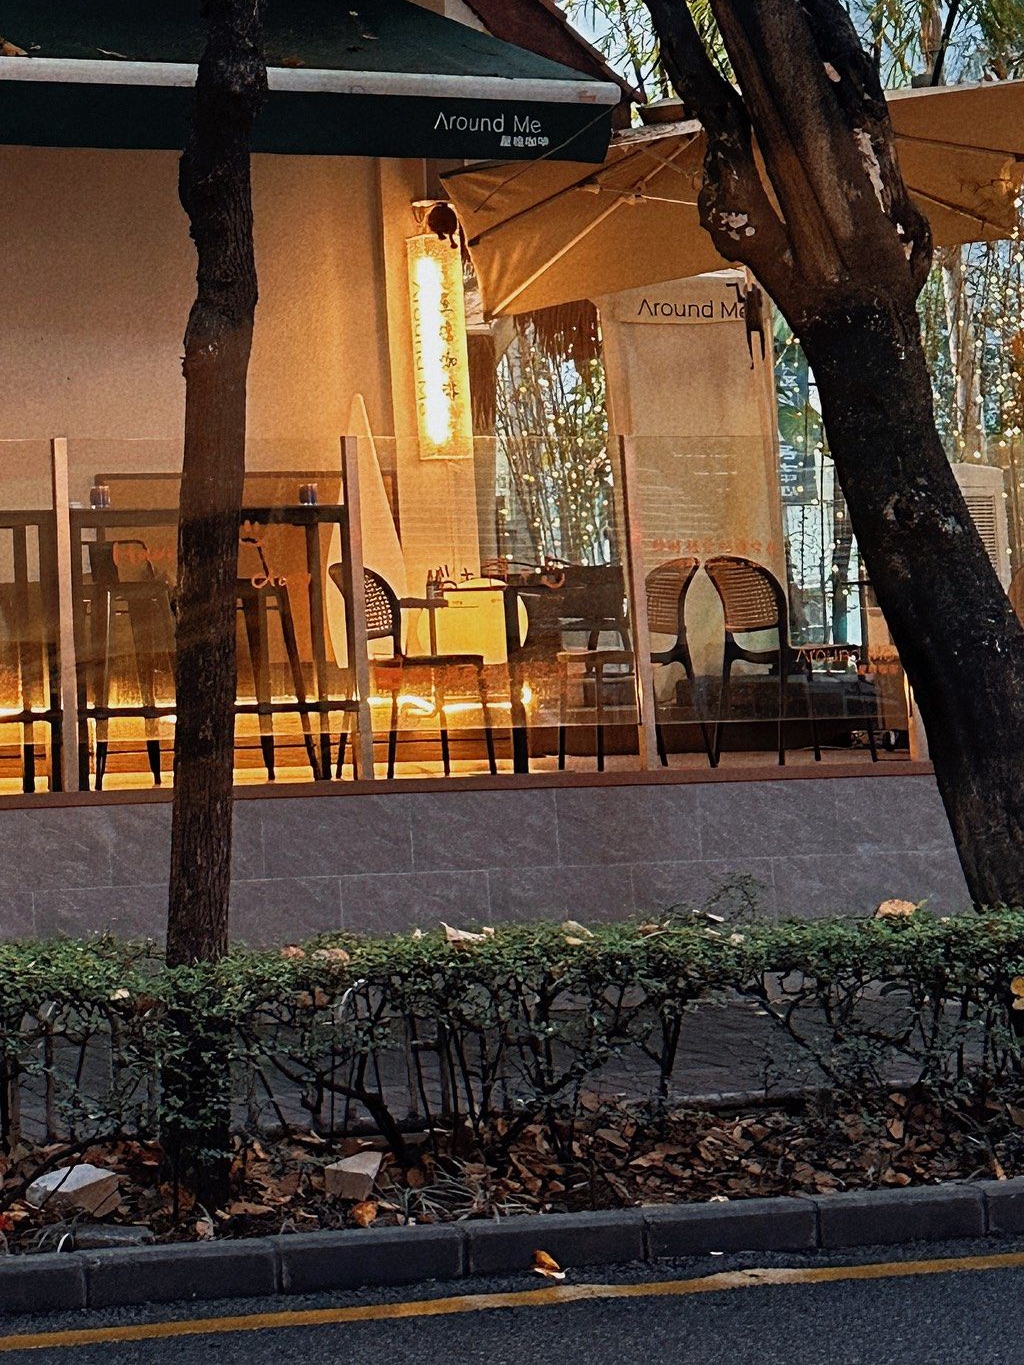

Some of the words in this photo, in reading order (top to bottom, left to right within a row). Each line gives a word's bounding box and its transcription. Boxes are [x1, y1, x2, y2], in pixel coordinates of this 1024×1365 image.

[433, 111, 505, 133] Around
[513, 115, 542, 133] Me
[637, 298, 714, 319] Around
